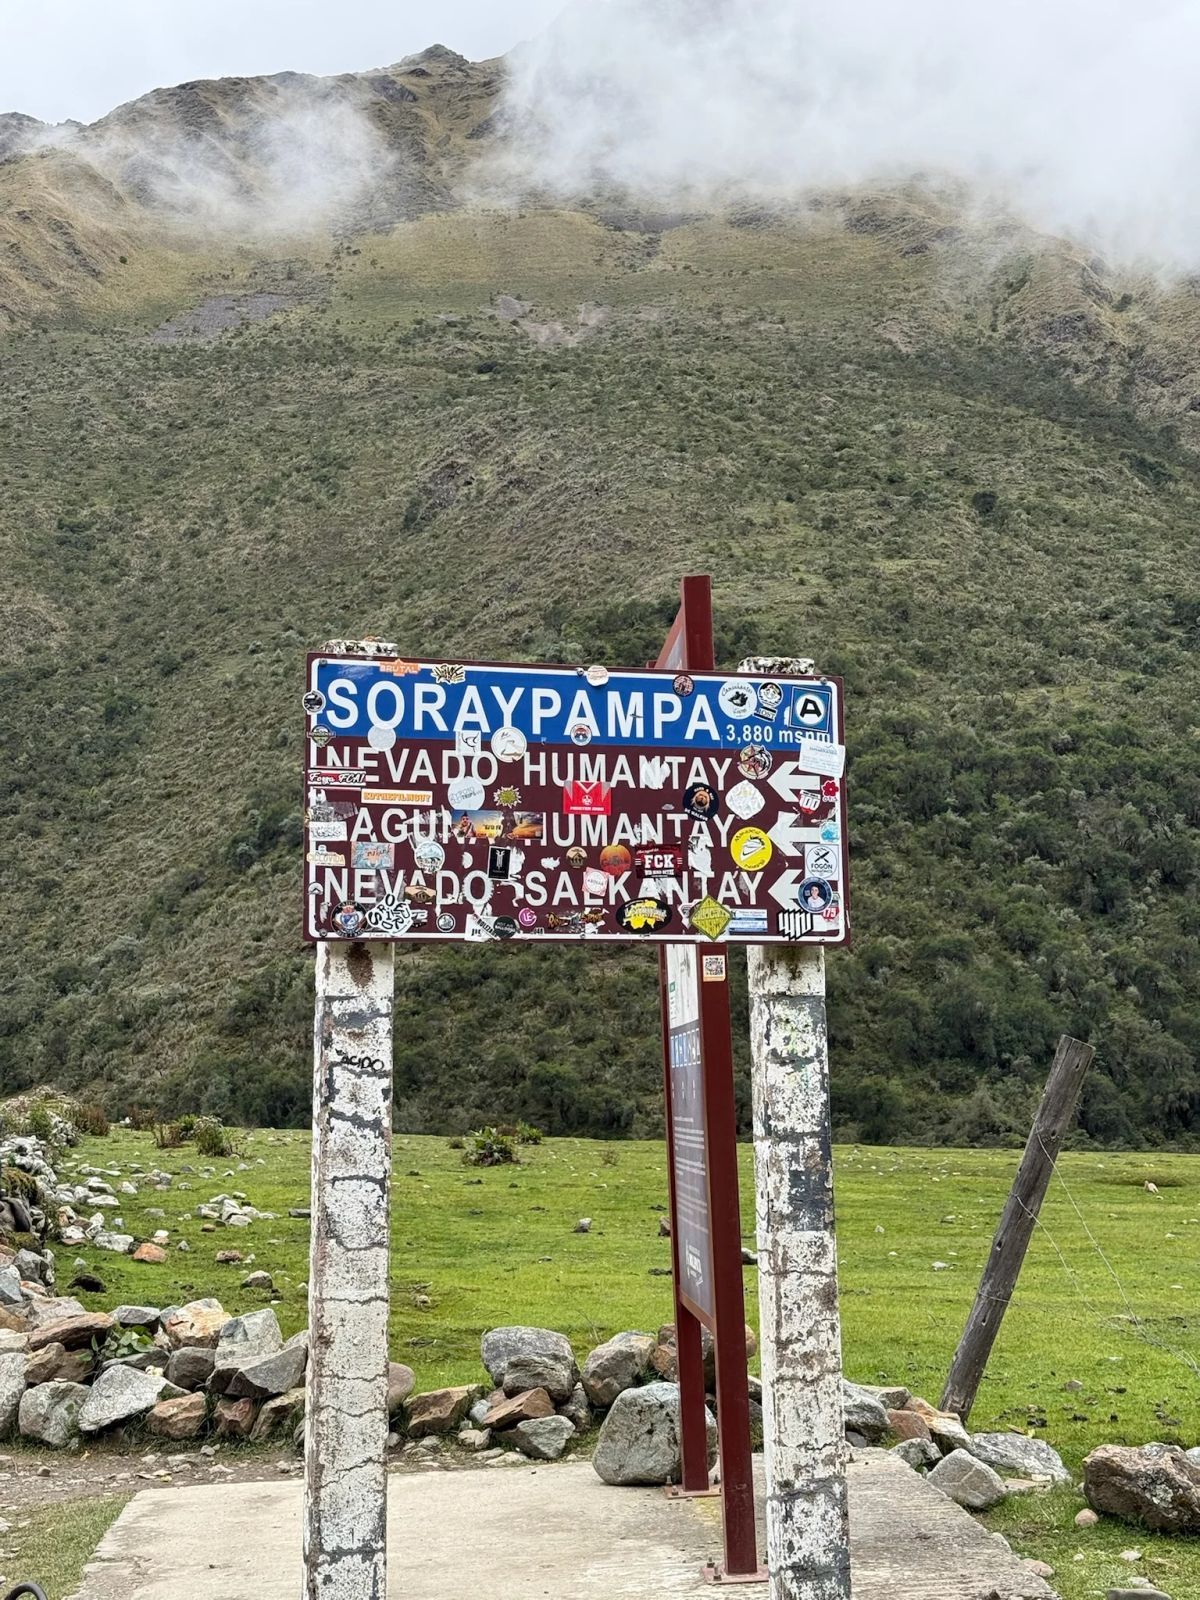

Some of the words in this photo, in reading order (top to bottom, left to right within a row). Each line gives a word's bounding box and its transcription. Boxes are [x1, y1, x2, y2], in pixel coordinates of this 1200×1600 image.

[326, 678, 721, 741] SORAYPAMPA
[726, 724, 773, 744] 3,880
[326, 746, 499, 787] NEVADO
[644, 853, 675, 869] FCK
[324, 867, 493, 907] NEVADO
